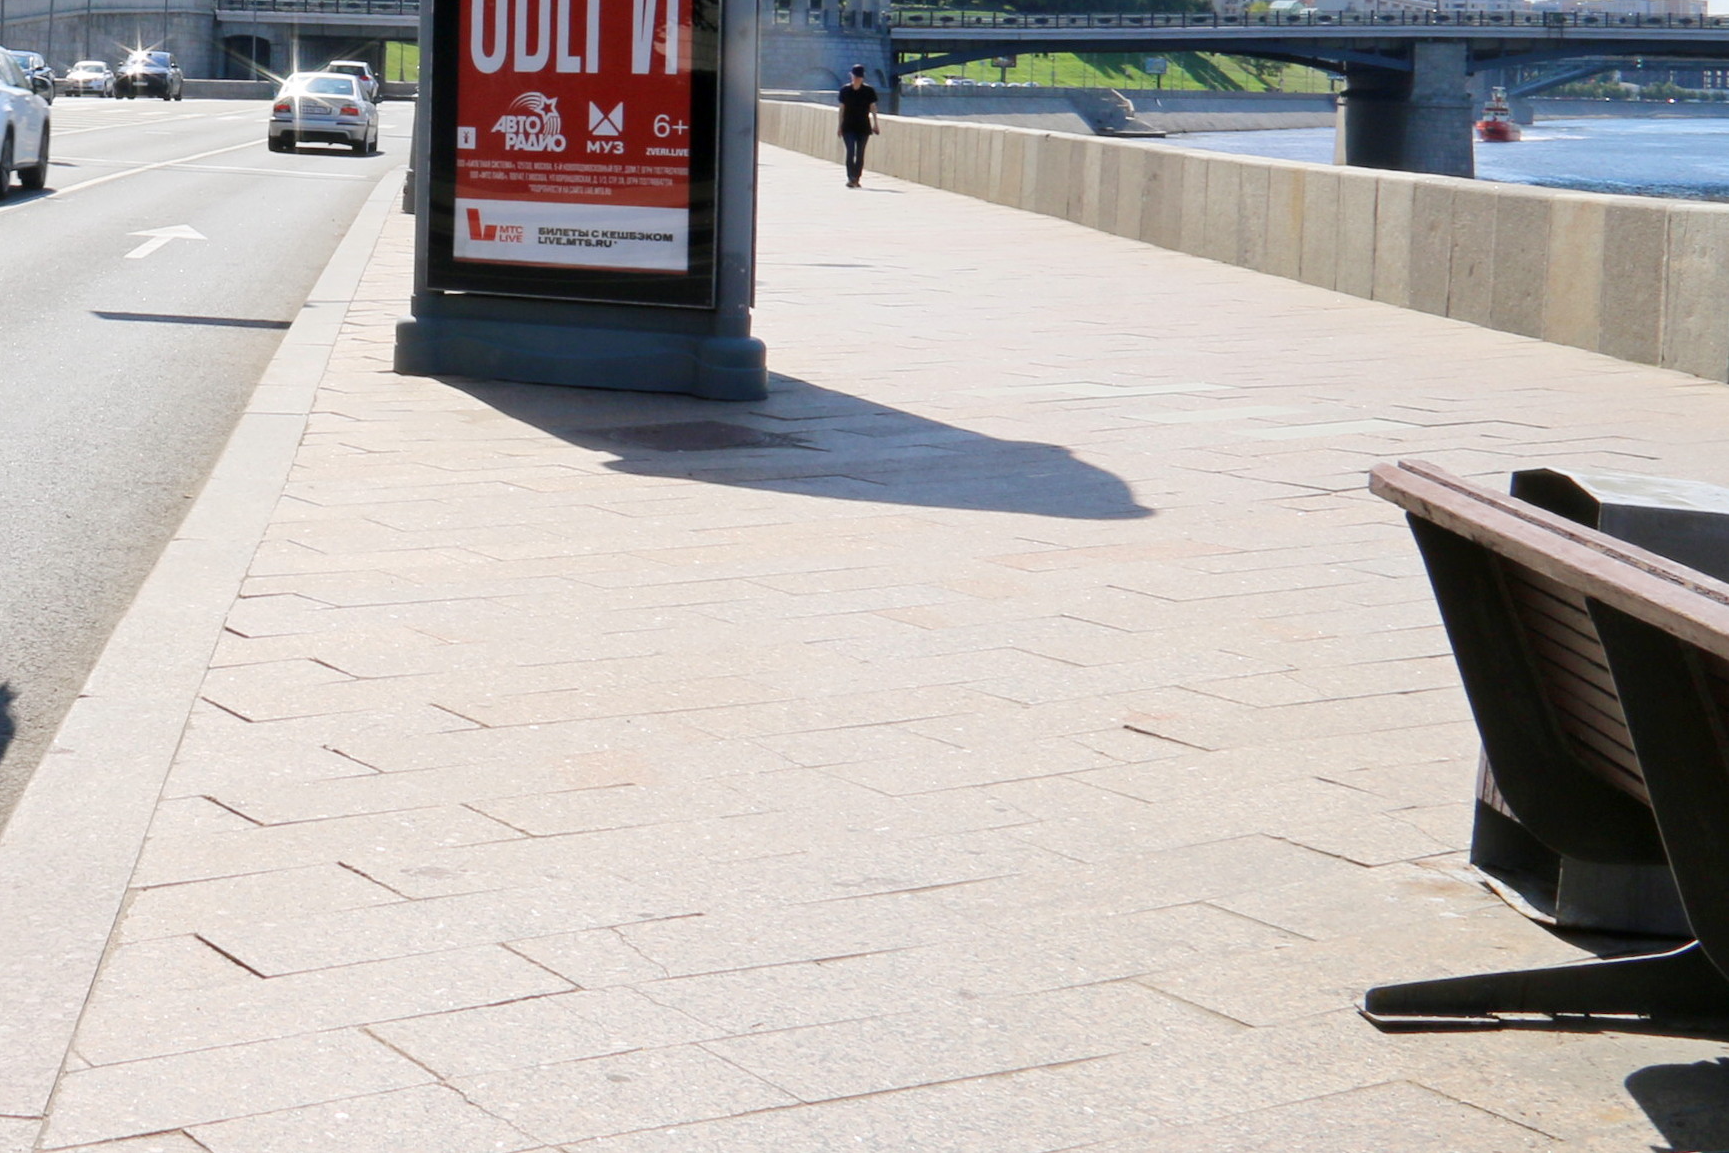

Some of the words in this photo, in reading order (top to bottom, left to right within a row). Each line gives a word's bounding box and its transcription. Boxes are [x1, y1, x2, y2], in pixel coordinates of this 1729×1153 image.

[491, 115, 541, 133] АВТО
[653, 114, 689, 138] 6+
[505, 134, 567, 153] РАДИО
[586, 140, 625, 155] МУЗ
[499, 225, 523, 234] МТС
[538, 226, 590, 238] БИЛЕТЫ
[592, 229, 601, 238] С
[602, 230, 673, 243] КЕШБЭКОМ
[499, 234, 523, 243] LIVE
